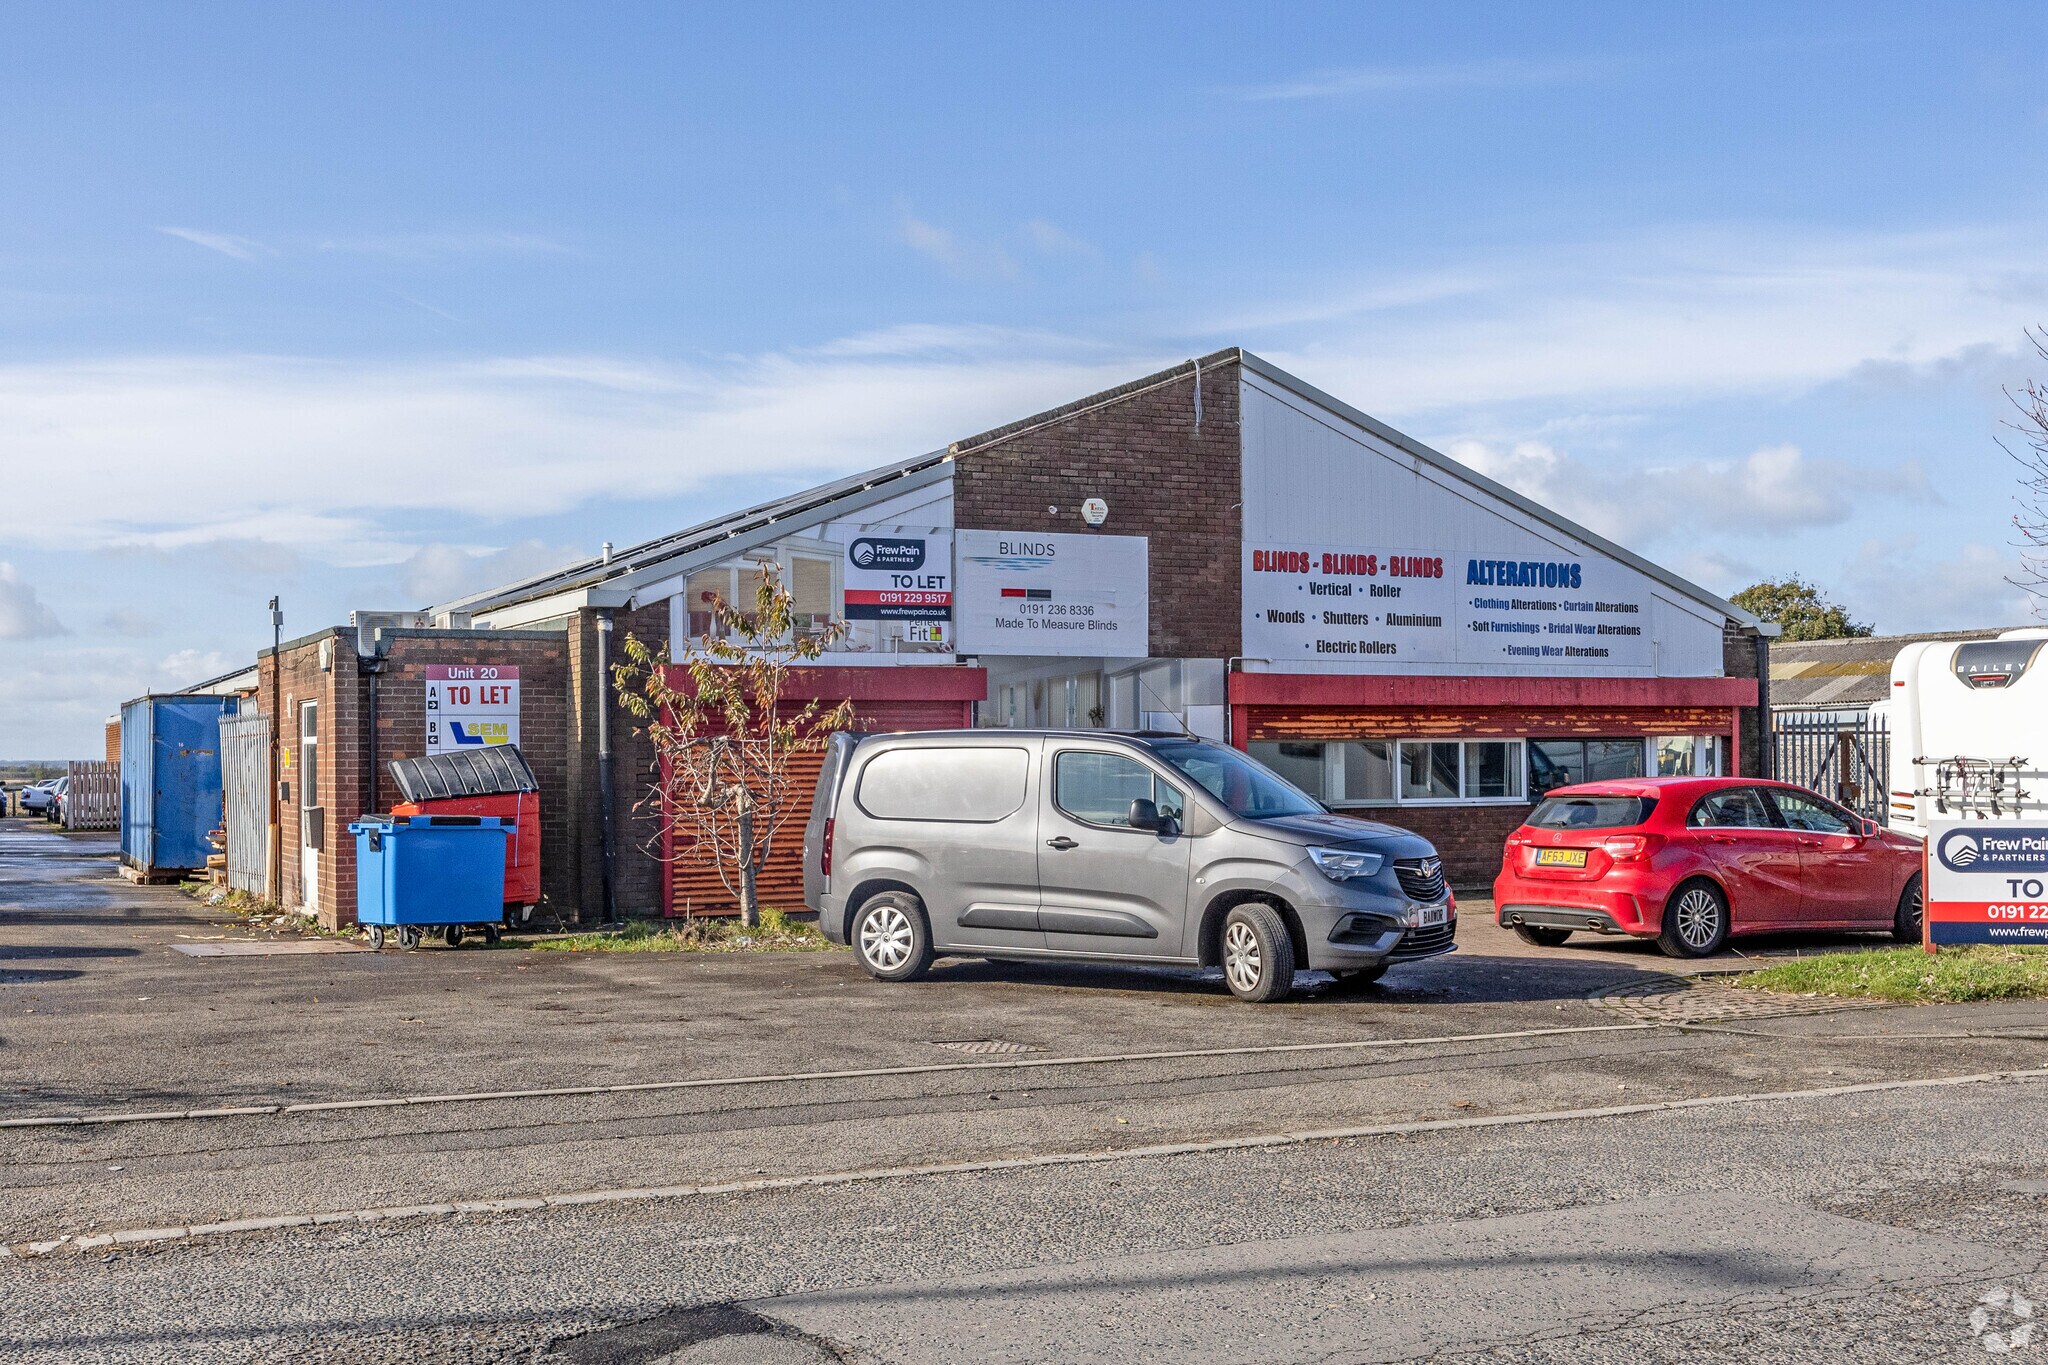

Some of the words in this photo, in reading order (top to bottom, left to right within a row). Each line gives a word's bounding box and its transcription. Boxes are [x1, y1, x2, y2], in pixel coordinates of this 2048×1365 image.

[876, 545, 900, 554] Frew
[900, 545, 920, 556] Pain
[1000, 541, 1055, 556] BLINDS
[1252, 549, 1310, 573] BLINDS
[1322, 552, 1378, 576] BLINDS
[1389, 555, 1444, 578] BLINDS
[1466, 559, 1582, 589] ALTERATIONS
[891, 574, 913, 588] TO
[918, 575, 946, 589] LET
[1309, 581, 1352, 596] Vertical
[1370, 583, 1402, 598] Roller
[880, 592, 902, 603] 0191
[904, 593, 922, 603] 229
[924, 593, 947, 604] 9517
[1474, 597, 1510, 611] Clothing
[1511, 598, 1557, 611] Alterations
[1563, 600, 1594, 612] Curtain
[1594, 601, 1639, 613] Alterations
[880, 607, 947, 617] www.frewpain.co.uk
[1020, 603, 1044, 614] 0191
[1048, 604, 1067, 615] 236
[1069, 605, 1094, 616] 8336
[995, 617, 1024, 629] Made
[1026, 618, 1039, 629] To
[1041, 618, 1085, 630] Measure
[1087, 619, 1118, 631] Blinds
[1267, 609, 1305, 623] Woods
[1323, 610, 1369, 625] Shutters
[1386, 612, 1442, 627] Aluminium
[910, 626, 928, 641] Fit
[1472, 620, 1490, 632] Soft
[1491, 621, 1540, 634] Furnishings
[1548, 622, 1573, 634] Bridal
[1574, 623, 1596, 634] Wear
[1597, 624, 1641, 636] Alterations
[1316, 639, 1357, 654] Electric
[1359, 640, 1397, 654] Rollers
[1507, 644, 1540, 657] Evening
[1541, 645, 1564, 656] Wear
[1564, 646, 1609, 658] Alterations
[448, 667, 475, 679] Unit
[480, 667, 498, 679] 20
[1957, 663, 2025, 673] BAILEY
[429, 686, 437, 698] A
[447, 686, 471, 705] TO
[480, 686, 511, 704] LET
[429, 721, 437, 733] B
[1982, 837, 2020, 850] Frew
[1541, 851, 1564, 862] AF63
[1566, 852, 1585, 863] JXE
[1982, 853, 1990, 861] &
[1992, 853, 2046, 861] PARTNERS
[2006, 879, 2044, 898] TO
[1987, 904, 2025, 919] 0191
